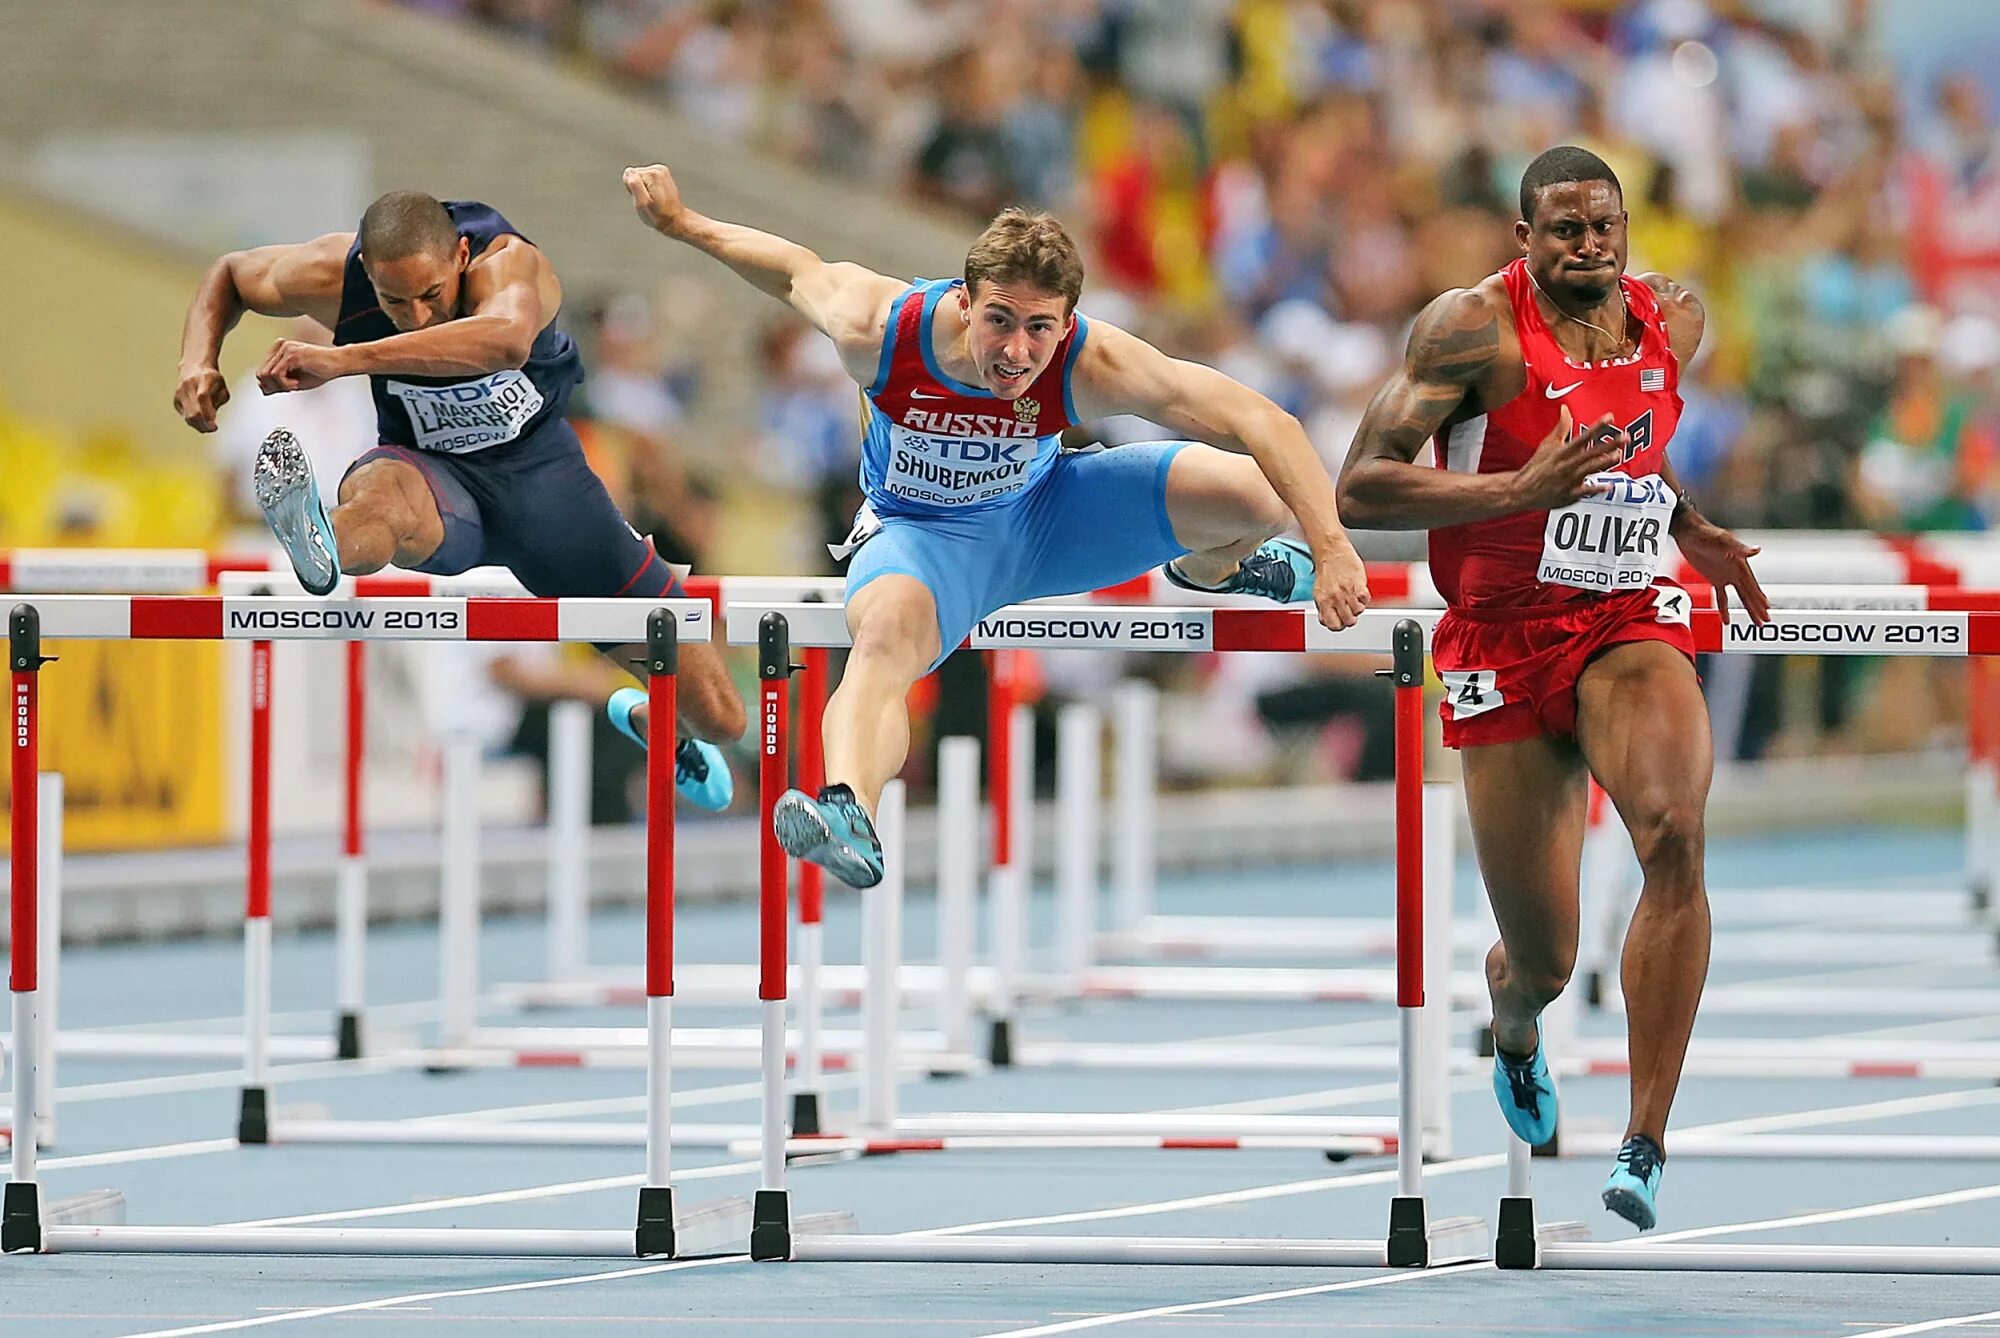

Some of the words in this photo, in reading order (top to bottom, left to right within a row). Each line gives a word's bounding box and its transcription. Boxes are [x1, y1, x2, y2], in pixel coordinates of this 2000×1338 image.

[423, 374, 508, 402] TDK
[430, 378, 527, 416] MARTINOT
[425, 432, 506, 450] MOSCOW
[930, 438, 1023, 464] TDK
[895, 449, 1027, 490] SHUBENKOV
[890, 482, 976, 504] MOSCOW
[230, 611, 376, 629] MOSCOW
[384, 611, 459, 629] 2013
[977, 620, 1122, 639] MOSCOW
[1130, 621, 1205, 640] 2013
[1730, 623, 1876, 643] MOSCOW
[1884, 625, 1960, 643] 2013
[1457, 673, 1484, 705] 4
[17, 695, 28, 747] MONDO
[766, 702, 777, 755] MONDO
